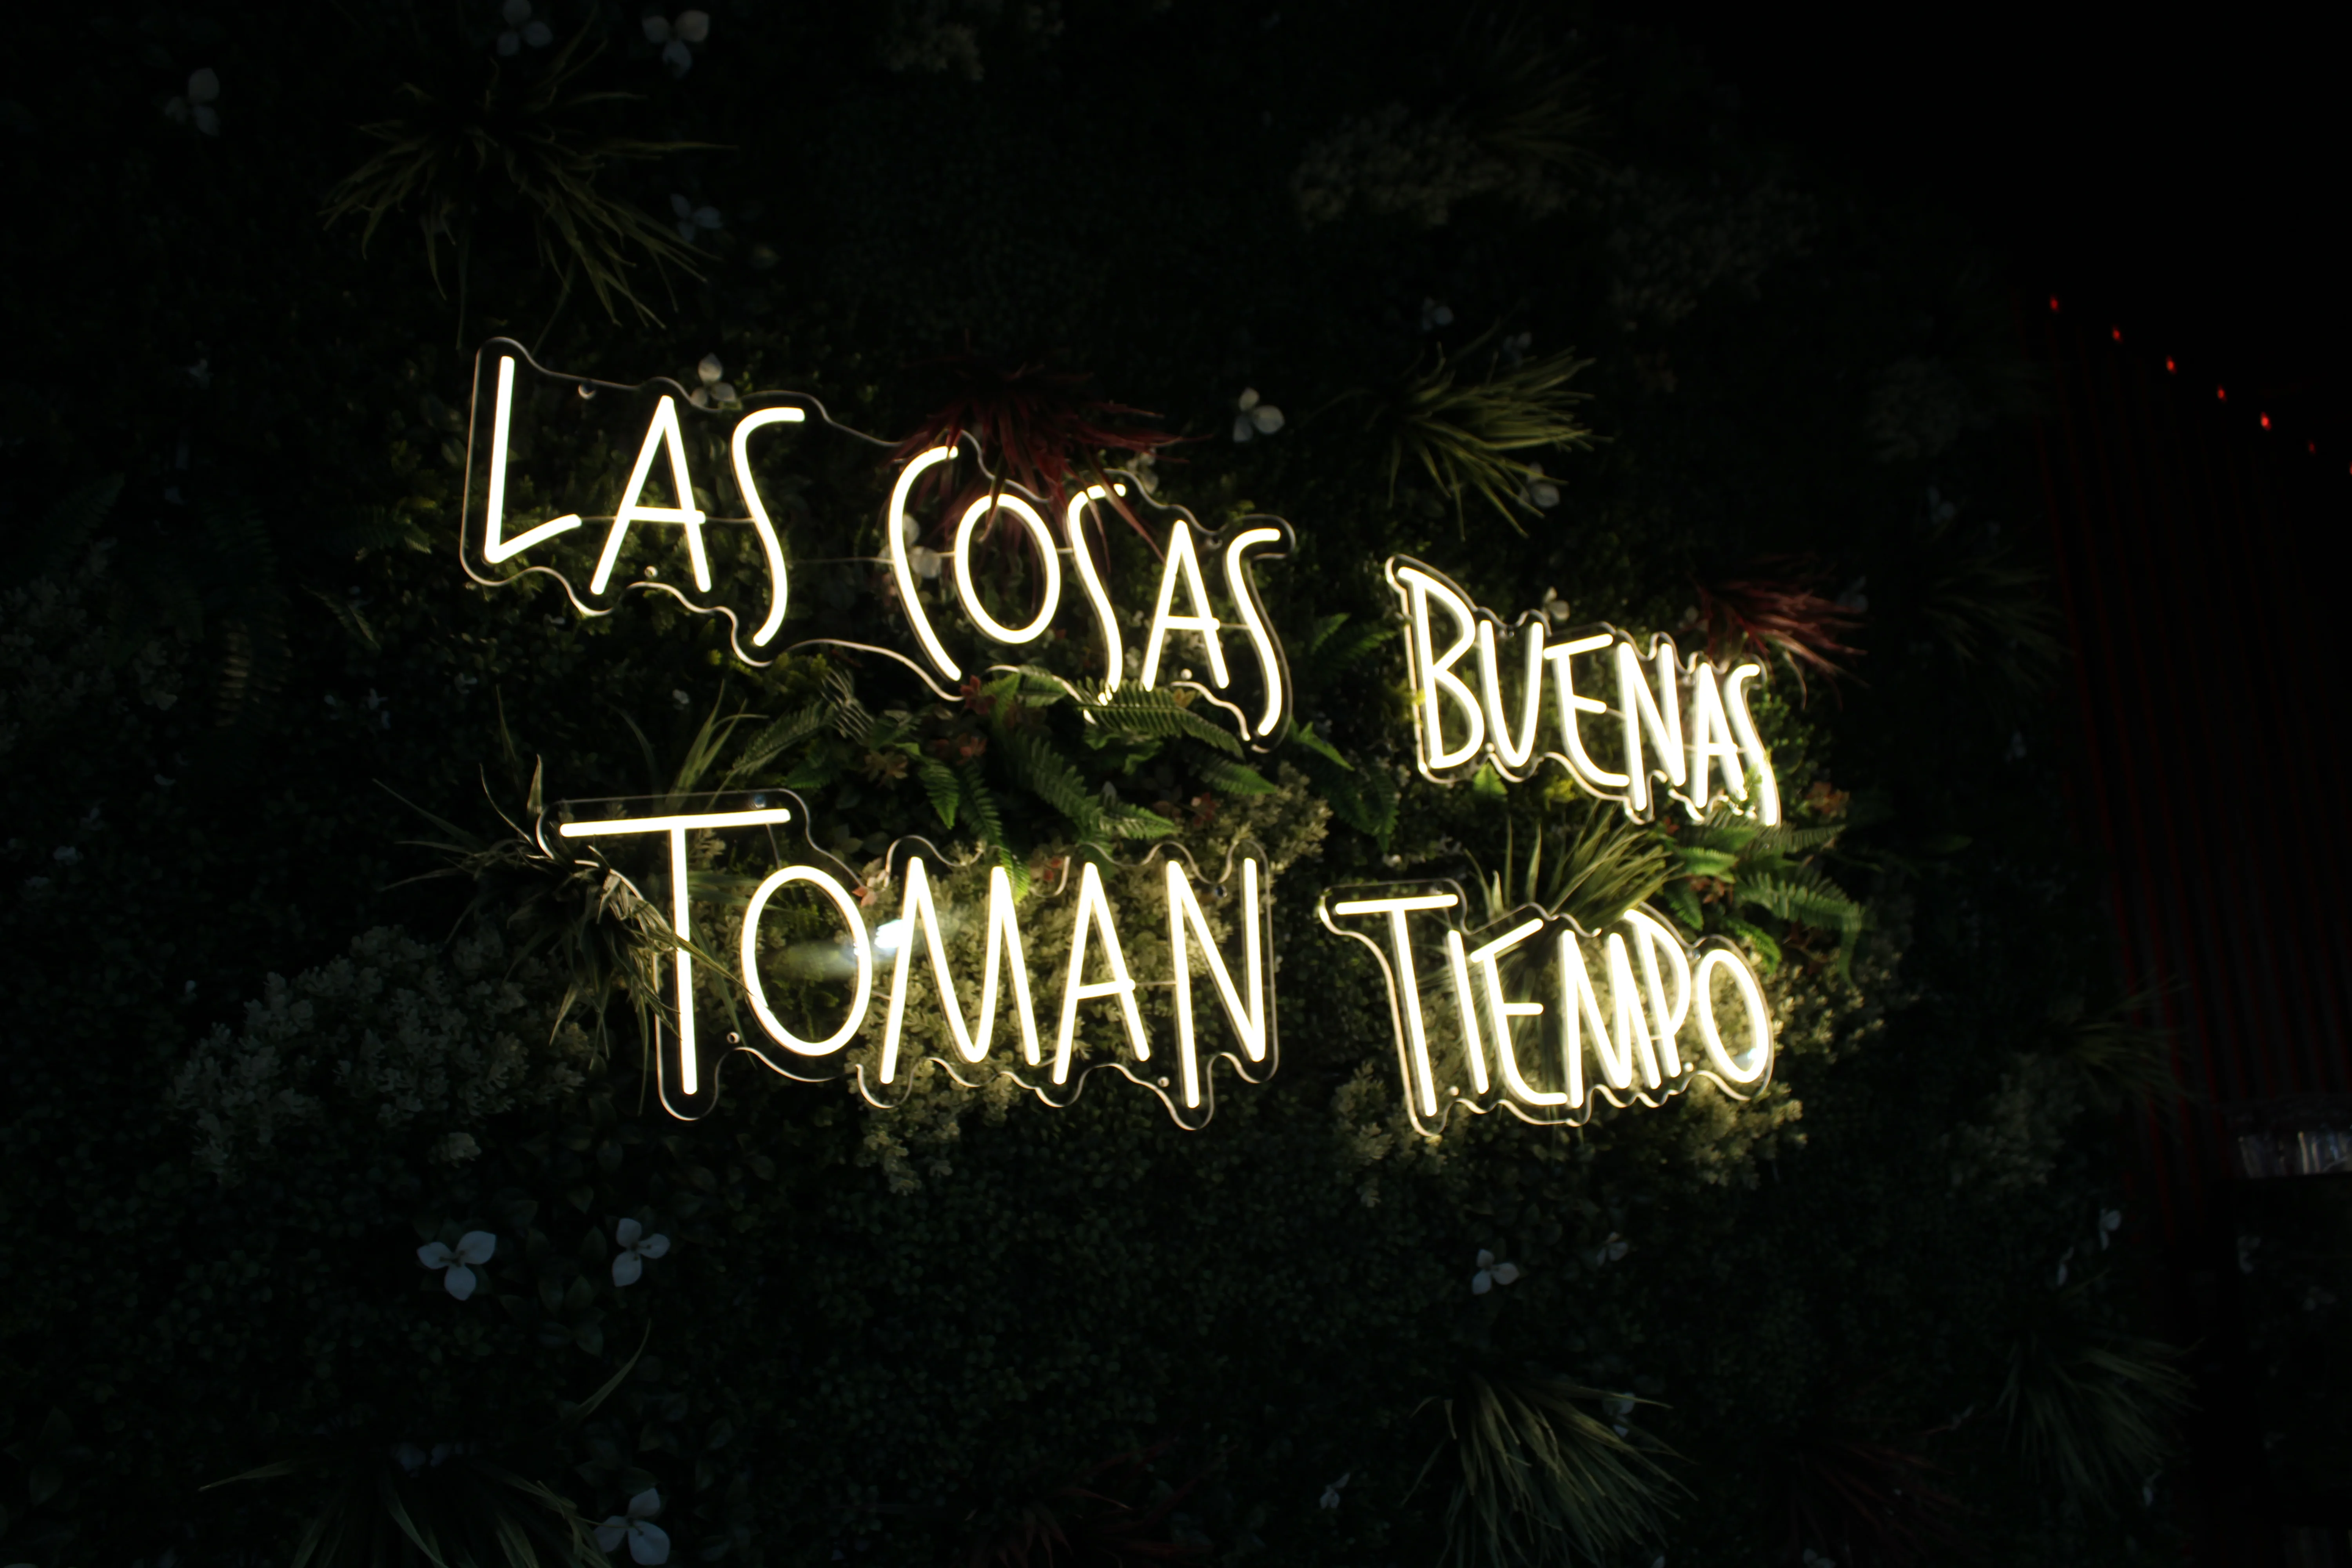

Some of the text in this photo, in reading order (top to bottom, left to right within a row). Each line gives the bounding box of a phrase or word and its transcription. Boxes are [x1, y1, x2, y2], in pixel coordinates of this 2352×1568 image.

[484, 355, 1780, 828] LAS COSAS BUENAS
[559, 807, 1770, 1118] TOMAN TIEMPO
